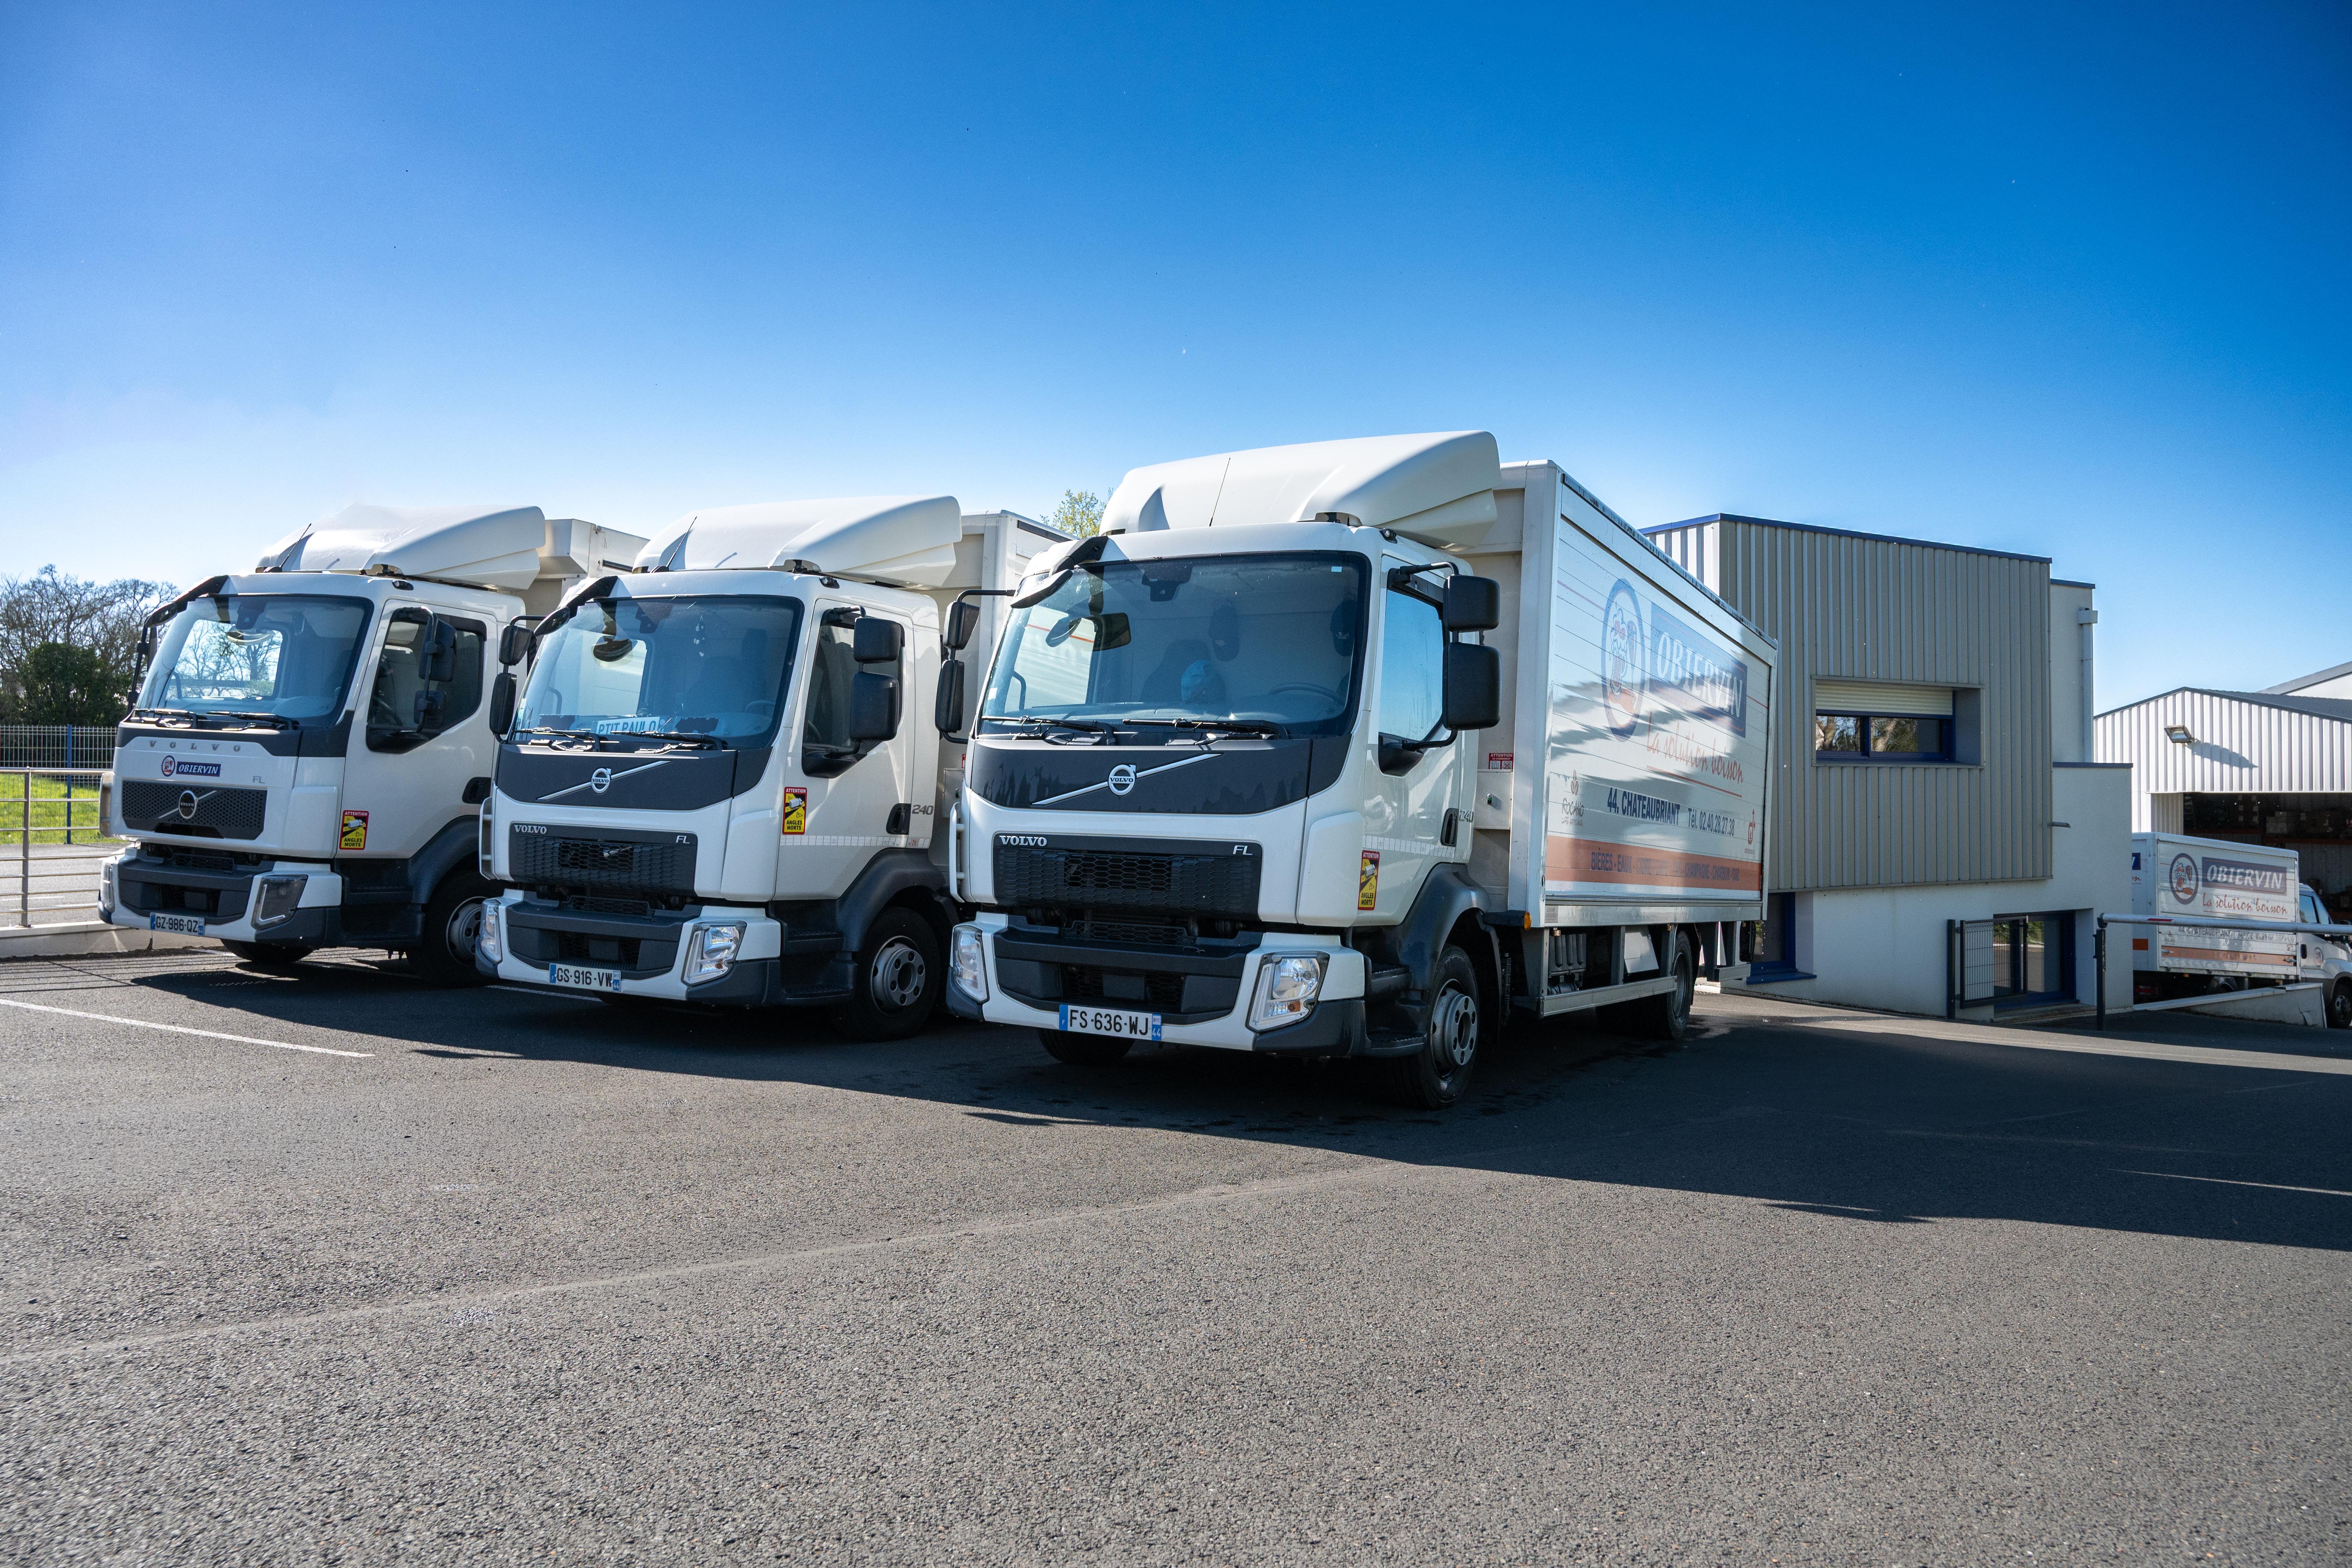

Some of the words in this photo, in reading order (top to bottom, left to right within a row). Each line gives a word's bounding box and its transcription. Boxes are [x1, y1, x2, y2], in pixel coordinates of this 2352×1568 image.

[1657, 632, 1743, 718] OBIERVIN
[598, 723, 620, 735] PTIT
[149, 740, 241, 752] VOLVO
[1647, 710, 1660, 754] La
[1664, 721, 1708, 772] solution
[1711, 738, 1744, 784] boisson
[178, 764, 218, 774] OBIERVIN
[253, 775, 265, 784] FL
[912, 804, 934, 815] 240
[1607, 787, 1619, 814] 44.
[1622, 791, 1680, 825] CHATEAUBRIANT
[1688, 808, 1697, 829] Tél.
[1699, 810, 1735, 836] 02.40.28.27.38
[1459, 810, 1474, 822] 240
[514, 825, 547, 834] VOLVO
[676, 835, 690, 844] FL
[999, 835, 1047, 847] VOLVO
[1232, 845, 1253, 855] FL
[2207, 864, 2282, 889] OBIERVIN
[2203, 892, 2213, 907] La
[2215, 894, 2253, 911] solution
[2256, 898, 2288, 915] boisson
[156, 916, 198, 933] GZ-986-QZ
[557, 968, 612, 987] GS-916-VW
[1070, 1009, 1148, 1036] FS-636-WJ
[1152, 1028, 1161, 1037] 44
